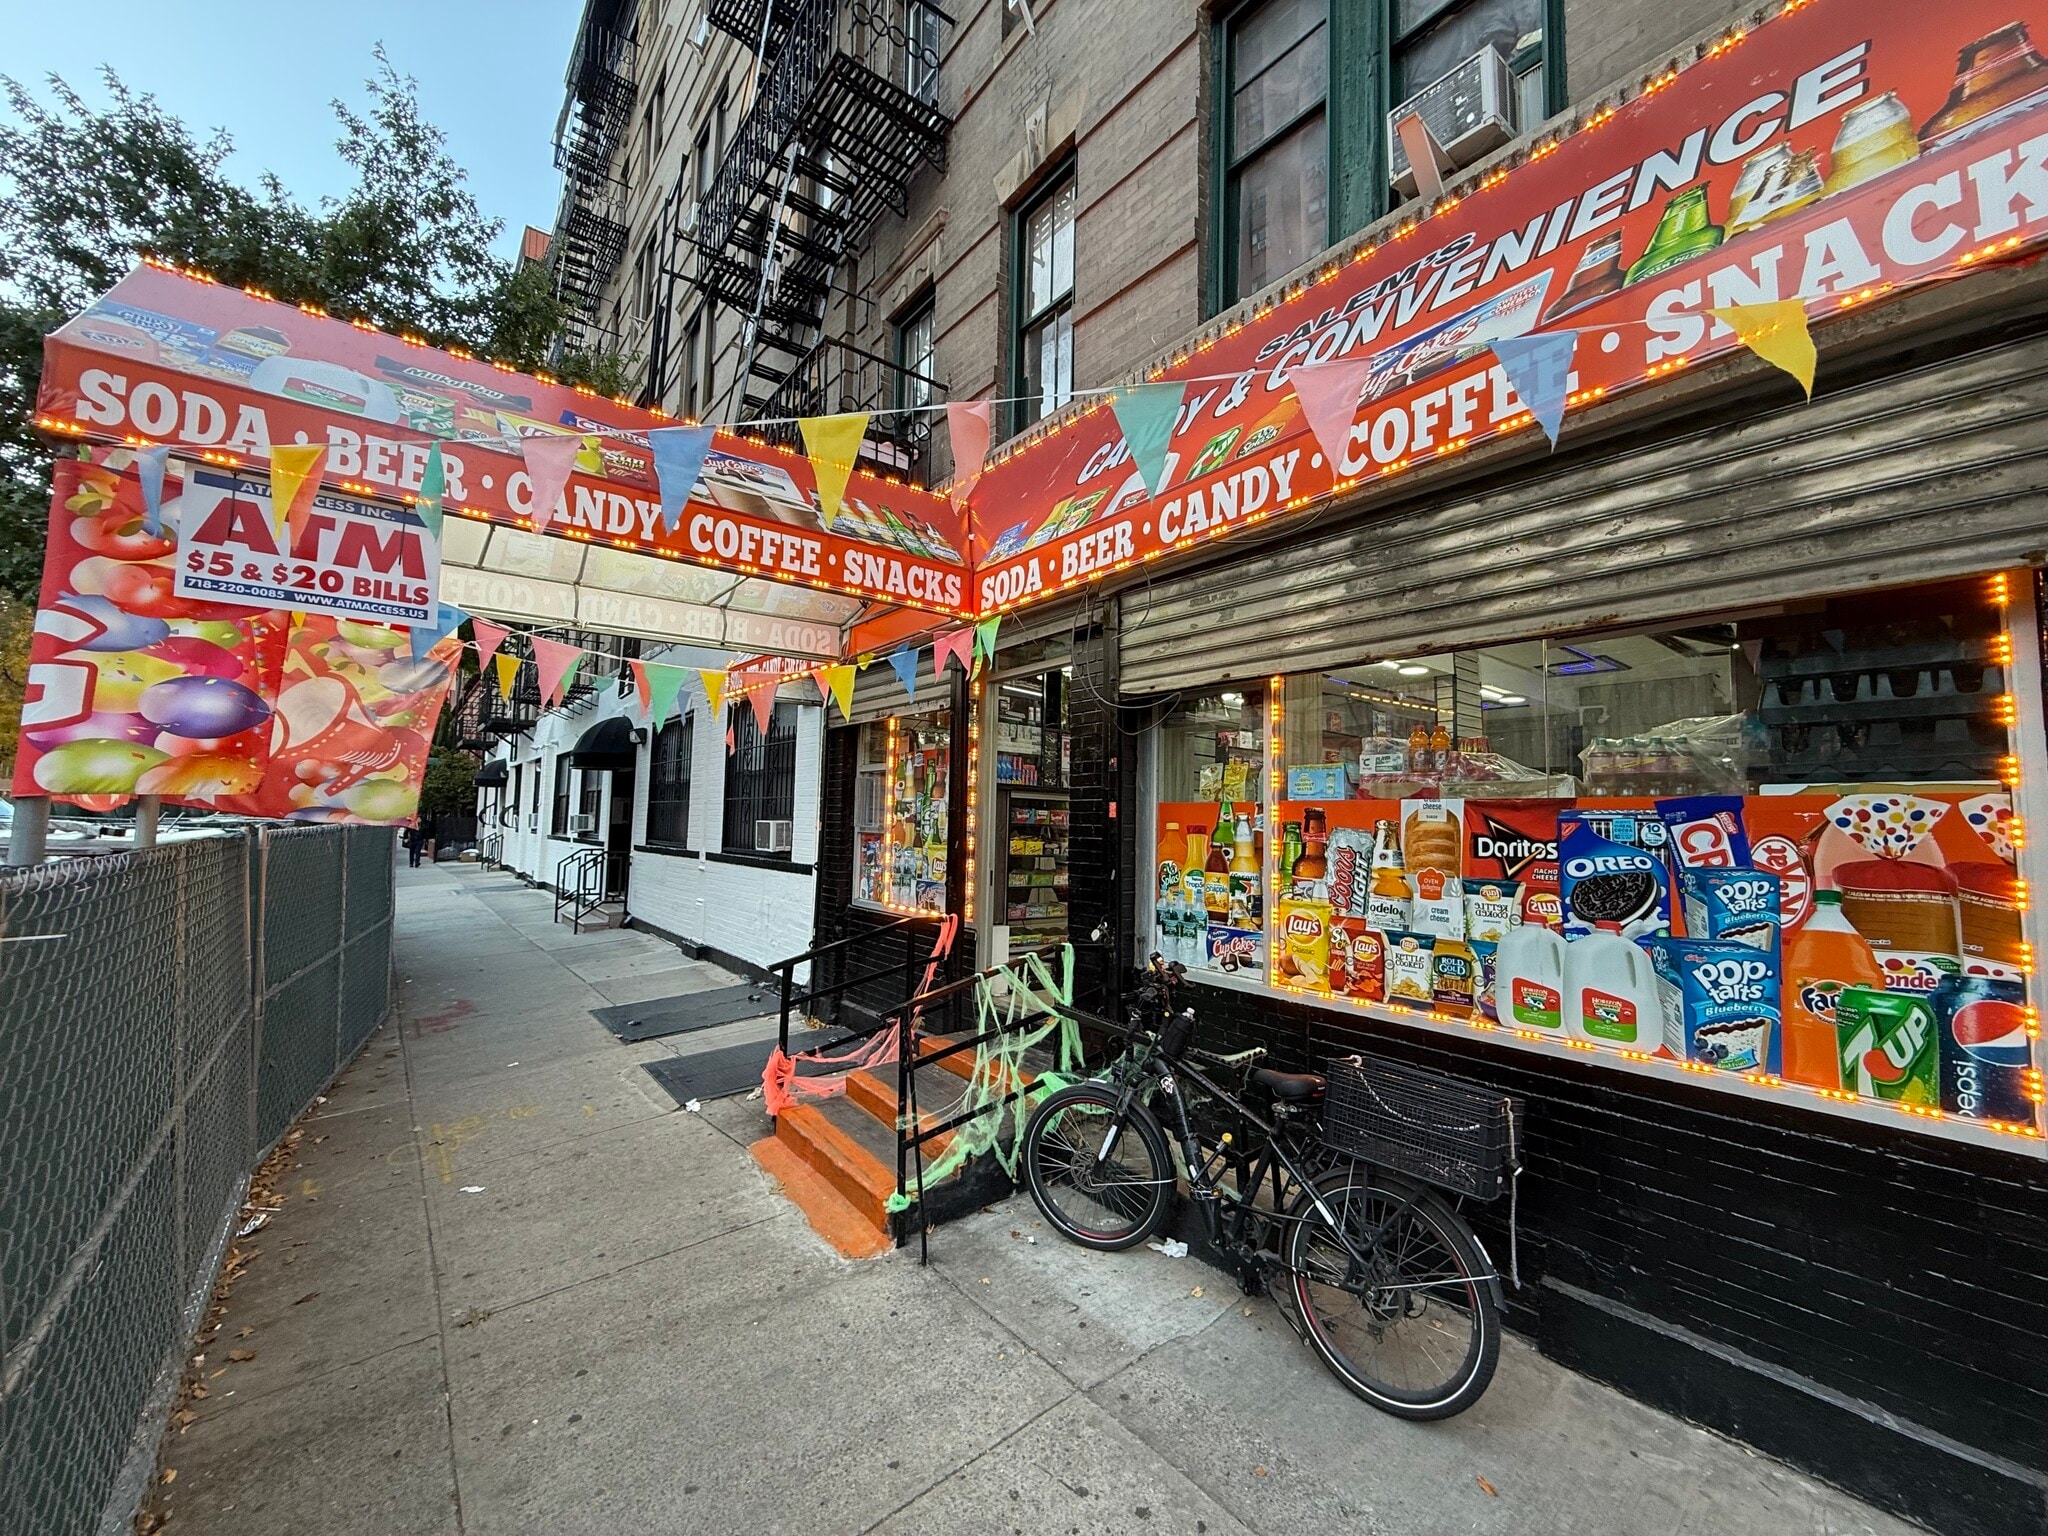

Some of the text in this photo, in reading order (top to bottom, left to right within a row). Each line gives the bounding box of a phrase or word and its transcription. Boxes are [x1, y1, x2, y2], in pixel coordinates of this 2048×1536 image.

[1213, 367, 1256, 418] &
[1265, 39, 1872, 393] CONVENIENCE
[1255, 231, 1477, 363] SALEM'S
[980, 557, 1043, 611] SODA
[1061, 519, 1135, 582] BEER
[1159, 447, 1301, 544] CANDY
[1338, 338, 1579, 477] COFFEE
[75, 368, 963, 608] SODA BEER CANDY COFFEE SNACKS
[360, 505, 396, 521] INC.
[191, 497, 427, 580] ATM
[186, 549, 430, 606] $5 & $20 BILLS
[187, 577, 426, 620] 718-220-0085 WWW.ATMACCESS.US
[1478, 836, 1558, 860] Doritos
[1566, 855, 1653, 878] OREO
[1329, 846, 1356, 912] Coors
[1351, 852, 1371, 916] LIGHT
[1370, 903, 1399, 914] odelo
[1429, 914, 1450, 924] cheese
[1430, 907, 1449, 916] cream
[1724, 912, 1770, 924] Blueberry
[1291, 945, 1315, 956] Classic
[1441, 956, 1464, 967] ROLD
[1439, 964, 1466, 976] GOLD
[1709, 983, 1763, 1005] tarts
[1705, 1004, 1766, 1017] Blueberry
